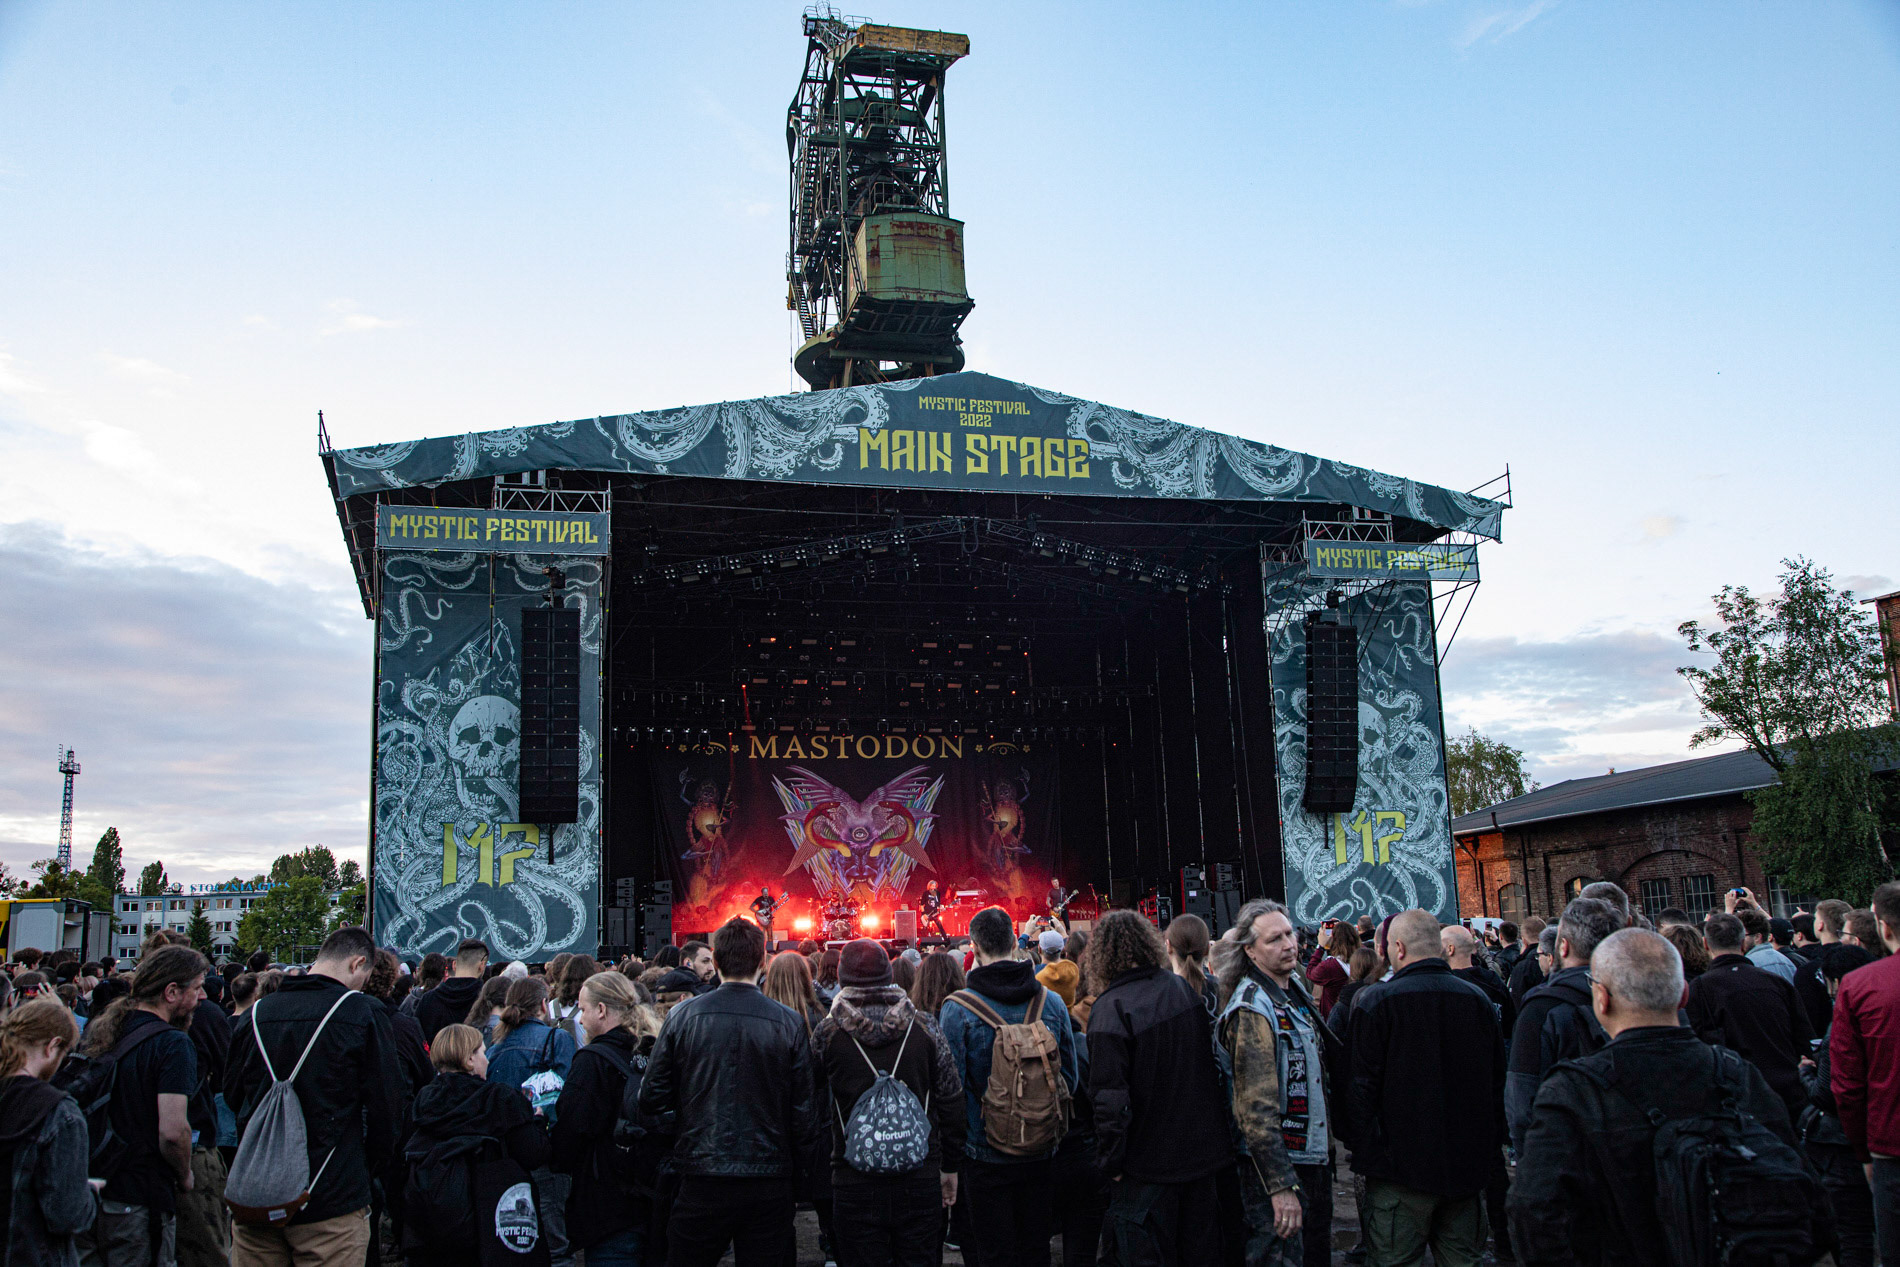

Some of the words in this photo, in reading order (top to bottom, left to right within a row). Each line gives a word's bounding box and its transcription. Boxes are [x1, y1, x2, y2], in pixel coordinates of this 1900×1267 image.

[919, 396, 967, 412] MYSTIC
[970, 399, 1030, 415] FESTIVAL
[960, 413, 992, 427] 2022
[857, 428, 952, 475] MAIN
[965, 433, 1091, 480] STAGE
[390, 514, 478, 540] MYSTIC
[486, 518, 598, 544] FESTIVAL
[1316, 547, 1382, 569] MYSTIC
[748, 734, 965, 759] MASTODON
[190, 882, 255, 893] STOCZNIA
[882, 1130, 911, 1140] fortum
